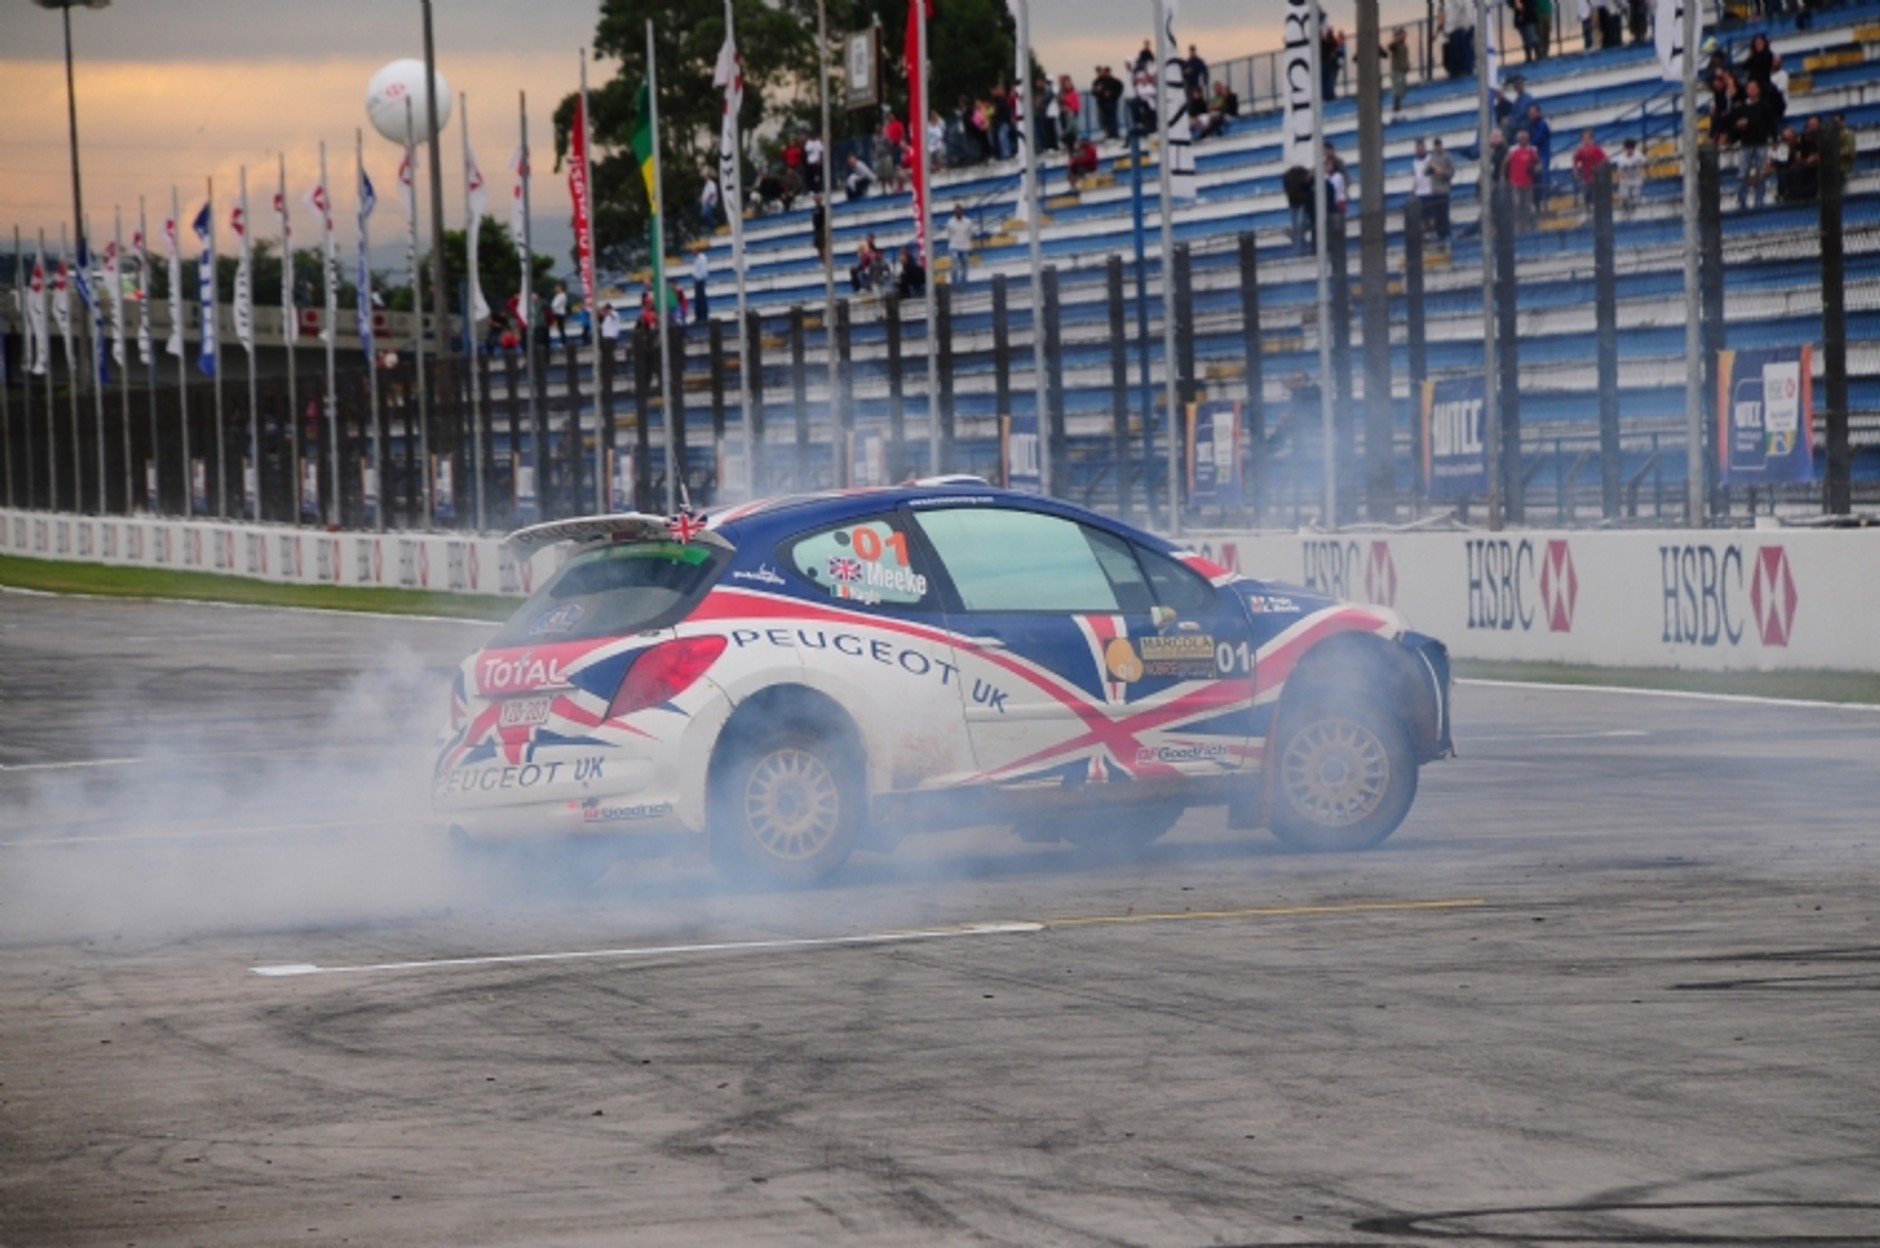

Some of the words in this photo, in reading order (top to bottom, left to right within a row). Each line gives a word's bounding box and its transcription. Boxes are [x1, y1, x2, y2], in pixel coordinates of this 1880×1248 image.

[852, 525, 909, 567] 01
[866, 562, 927, 595] Meeke
[1465, 539, 1535, 631] HSBC
[1660, 544, 1745, 645] HSBC
[484, 656, 568, 689] TOTAL
[732, 629, 960, 685] PEUGEOT
[972, 679, 1008, 713] UK
[1217, 641, 1250, 673] 01
[434, 762, 564, 790] PEUGEOT
[574, 757, 605, 781] UK
